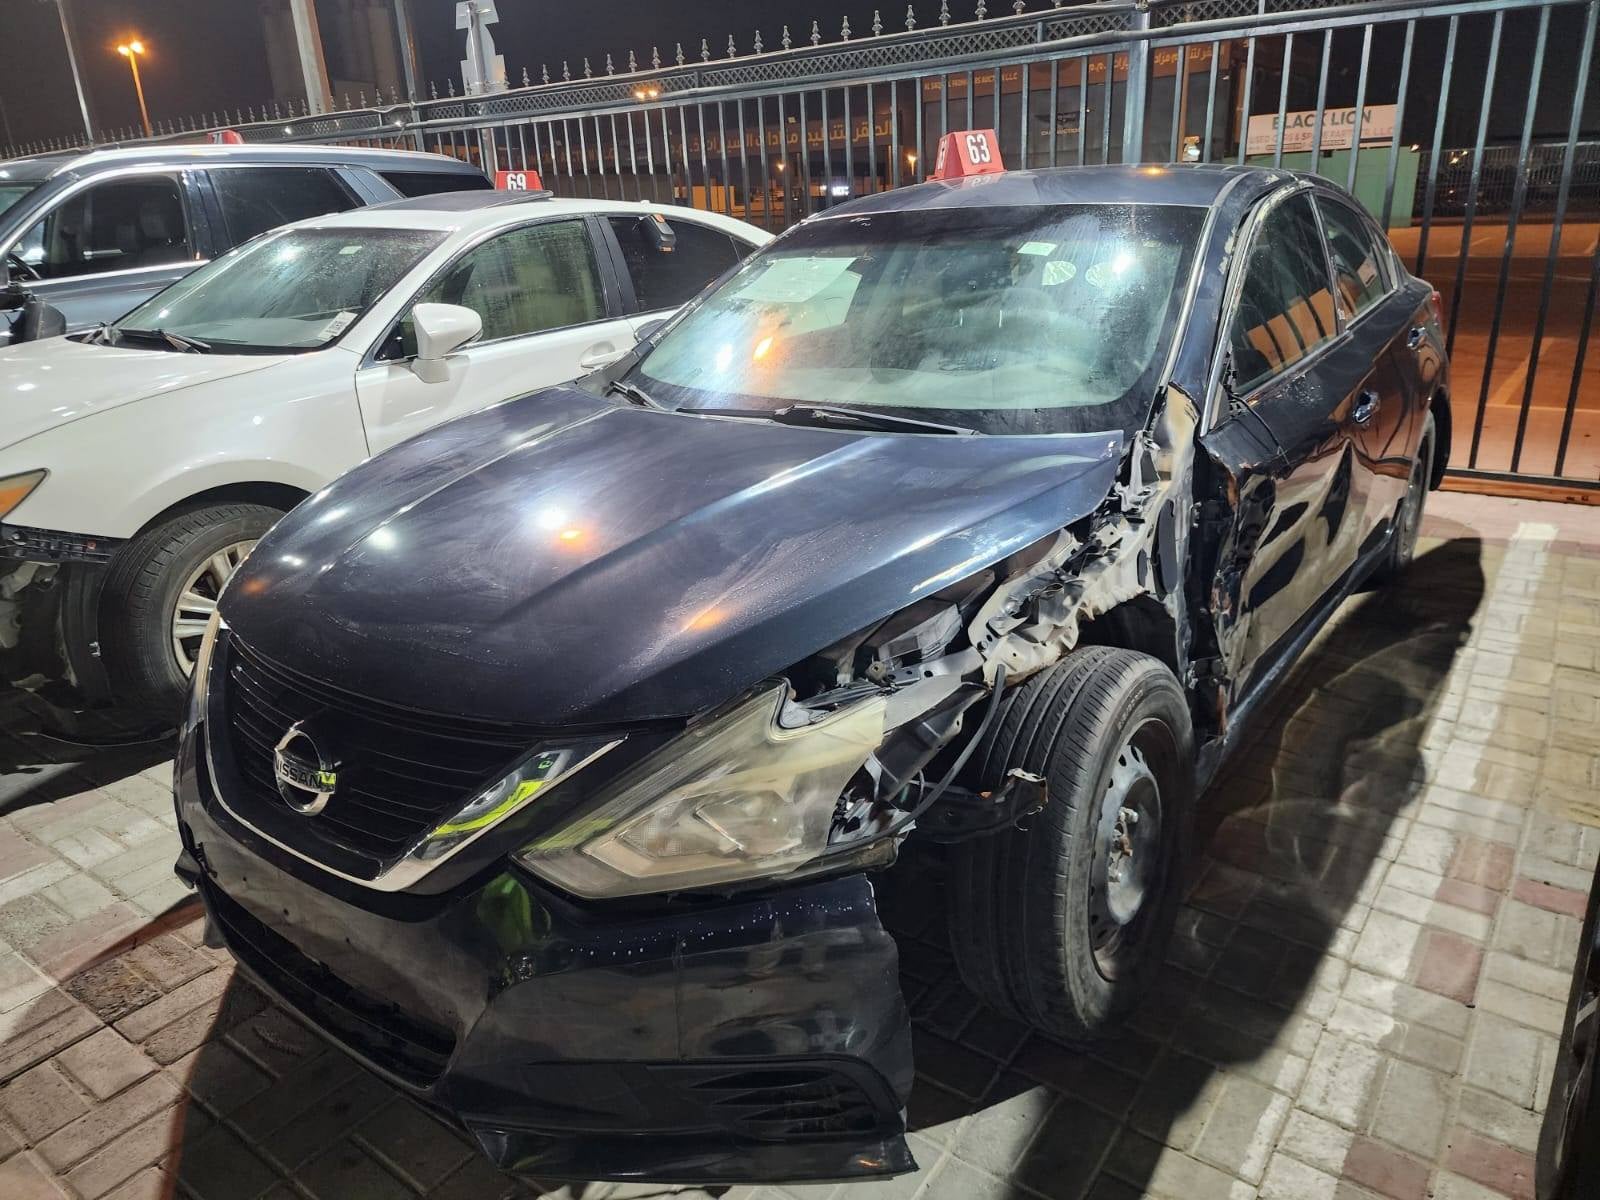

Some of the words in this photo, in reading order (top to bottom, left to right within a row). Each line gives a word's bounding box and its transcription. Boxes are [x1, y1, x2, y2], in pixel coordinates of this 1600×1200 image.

[1331, 110, 1372, 126] LION
[966, 133, 991, 164] 63
[506, 172, 527, 192] 69
[275, 758, 322, 789] NISSAN
